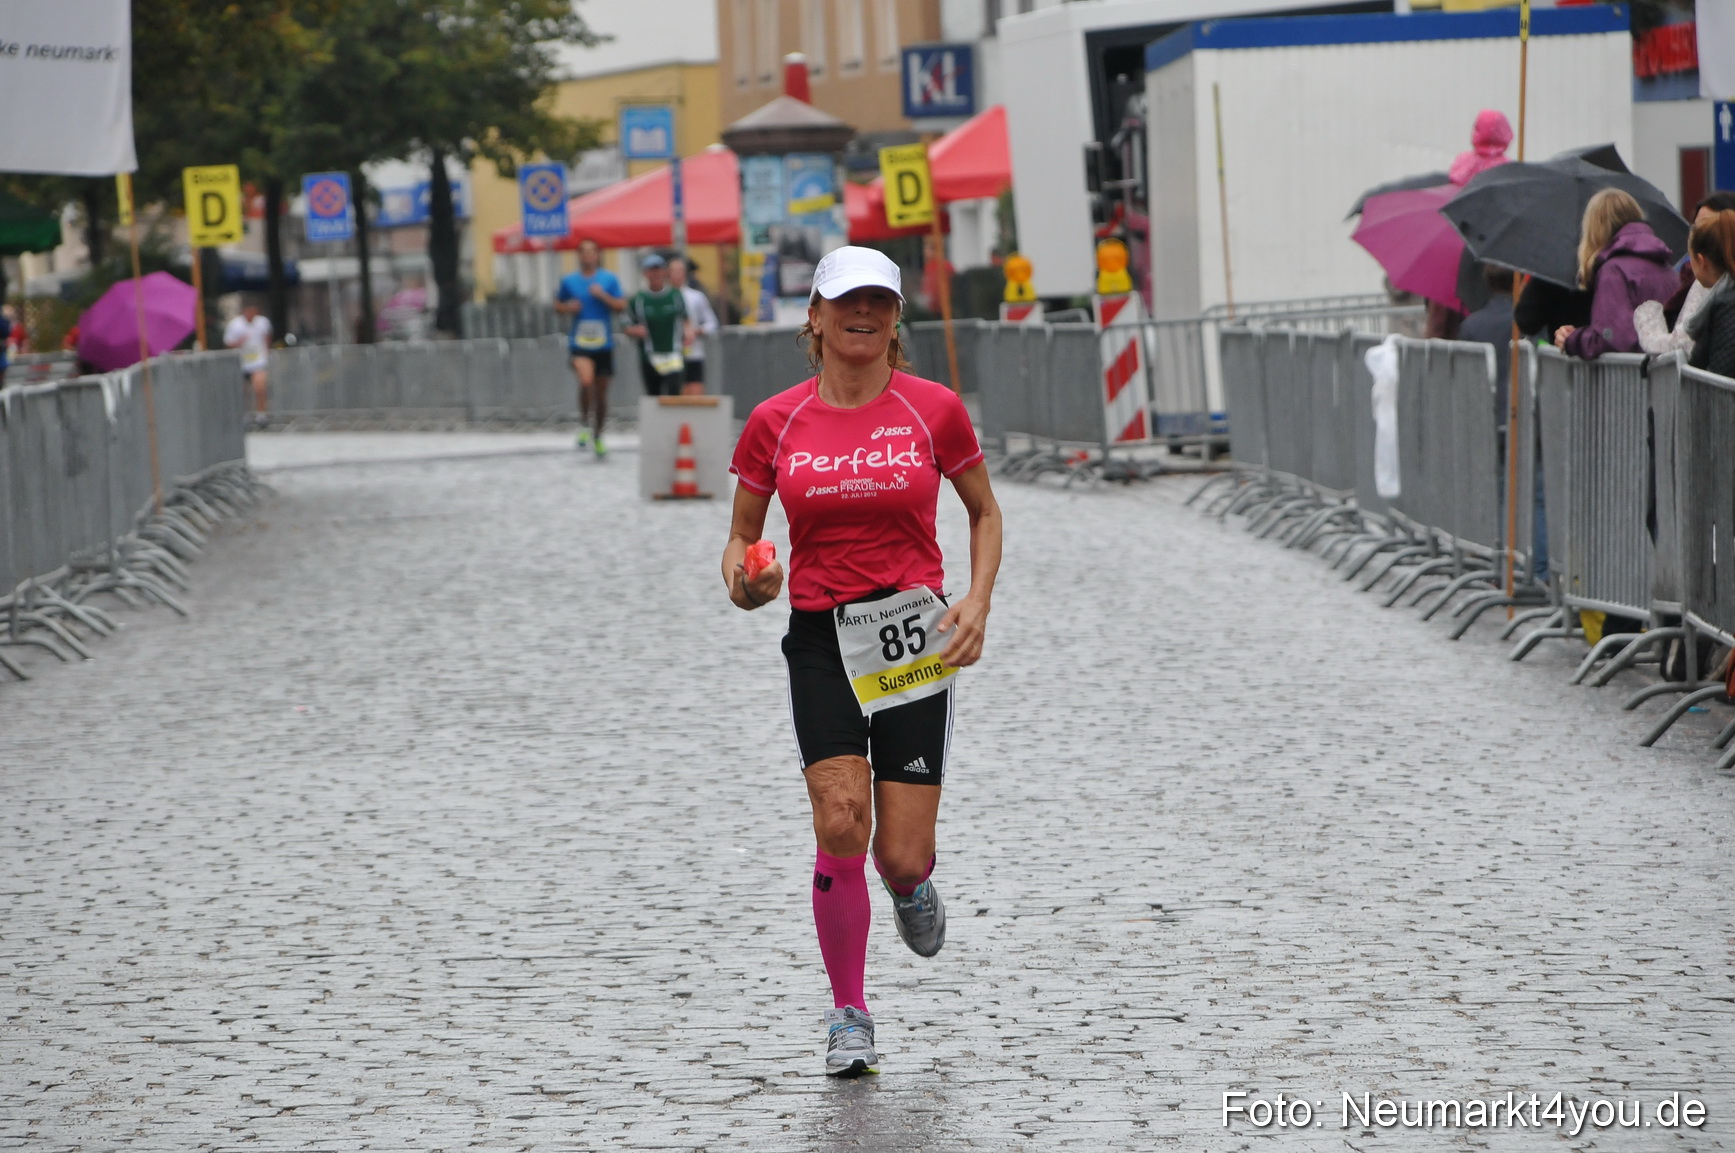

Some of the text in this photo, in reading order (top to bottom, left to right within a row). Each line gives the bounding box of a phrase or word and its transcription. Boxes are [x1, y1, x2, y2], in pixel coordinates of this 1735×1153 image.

[897, 170, 921, 205] D
[202, 191, 226, 226] D
[787, 441, 923, 477] Perfekt
[840, 481, 910, 493] FRAUENLAUF
[838, 595, 934, 628] PARTL Neumarkt
[879, 613, 926, 662] 85
[878, 662, 943, 692] Susanne
[903, 765, 931, 774] adidas
